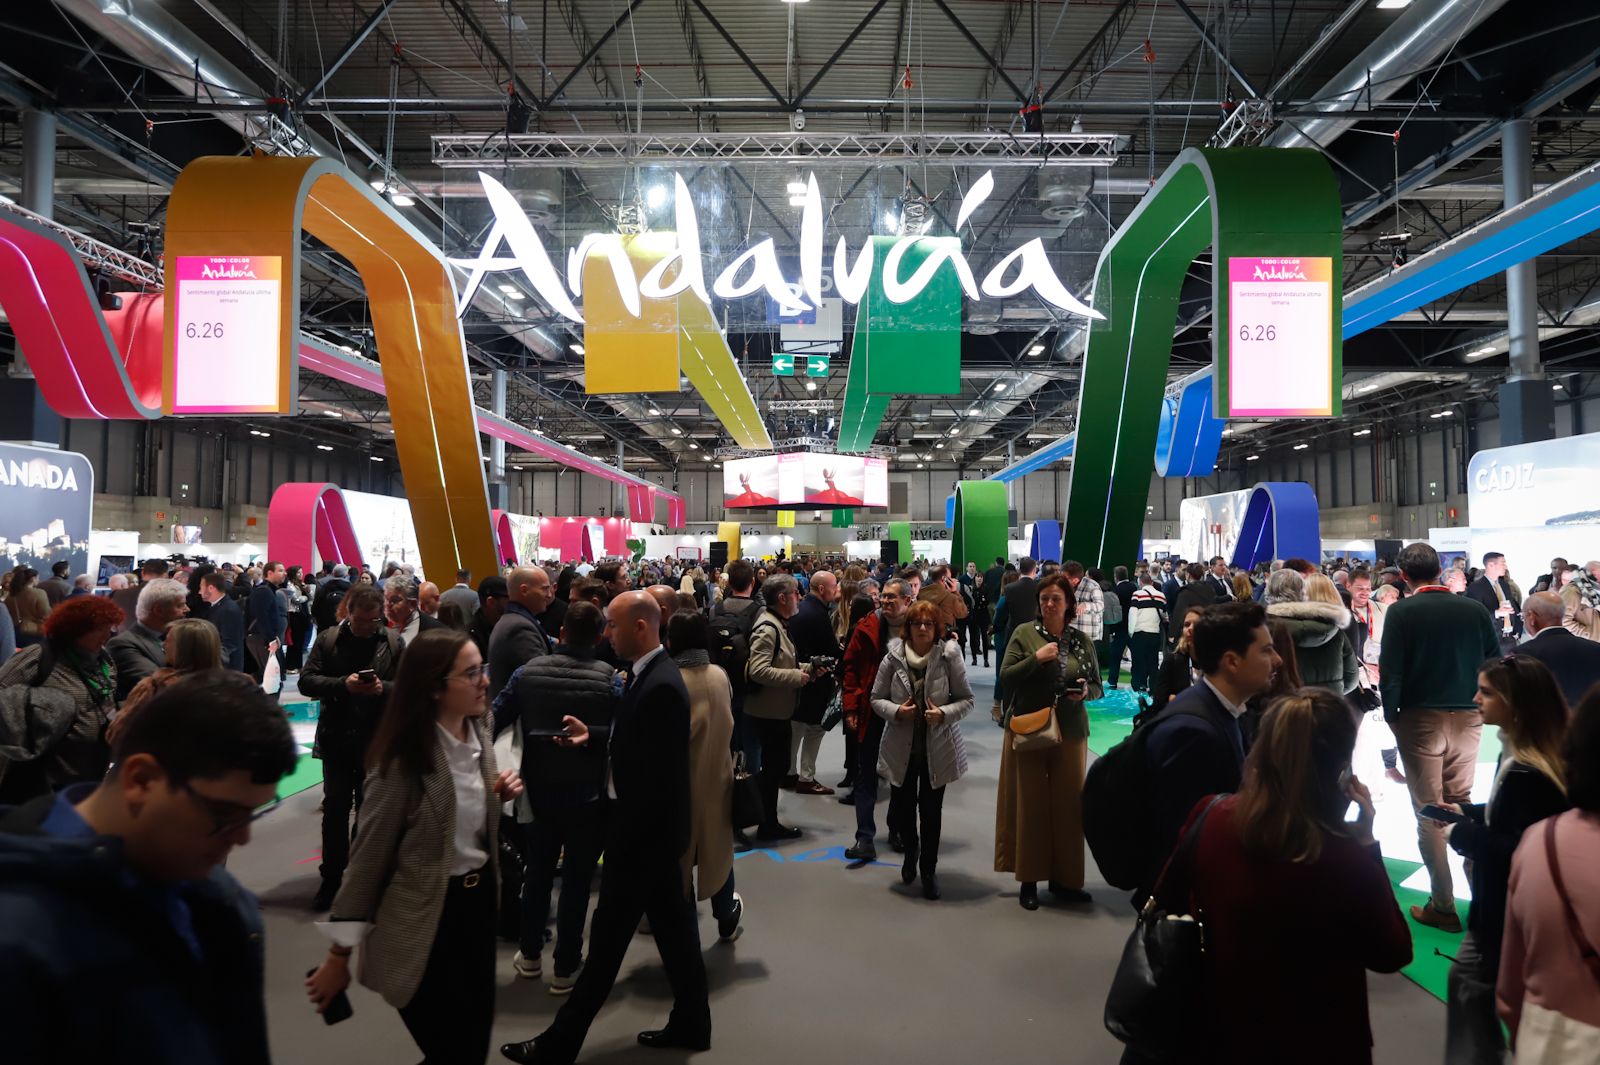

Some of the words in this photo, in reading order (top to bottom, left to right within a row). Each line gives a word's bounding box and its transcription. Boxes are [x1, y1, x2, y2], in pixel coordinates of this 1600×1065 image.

[447, 170, 1107, 323] Andalucía
[201, 264, 257, 279] Andalucía
[1253, 266, 1308, 280] Andalucía
[186, 322, 224, 338] 6.26
[1239, 324, 1276, 341] 6.26
[1475, 460, 1535, 493] CÁDIZ
